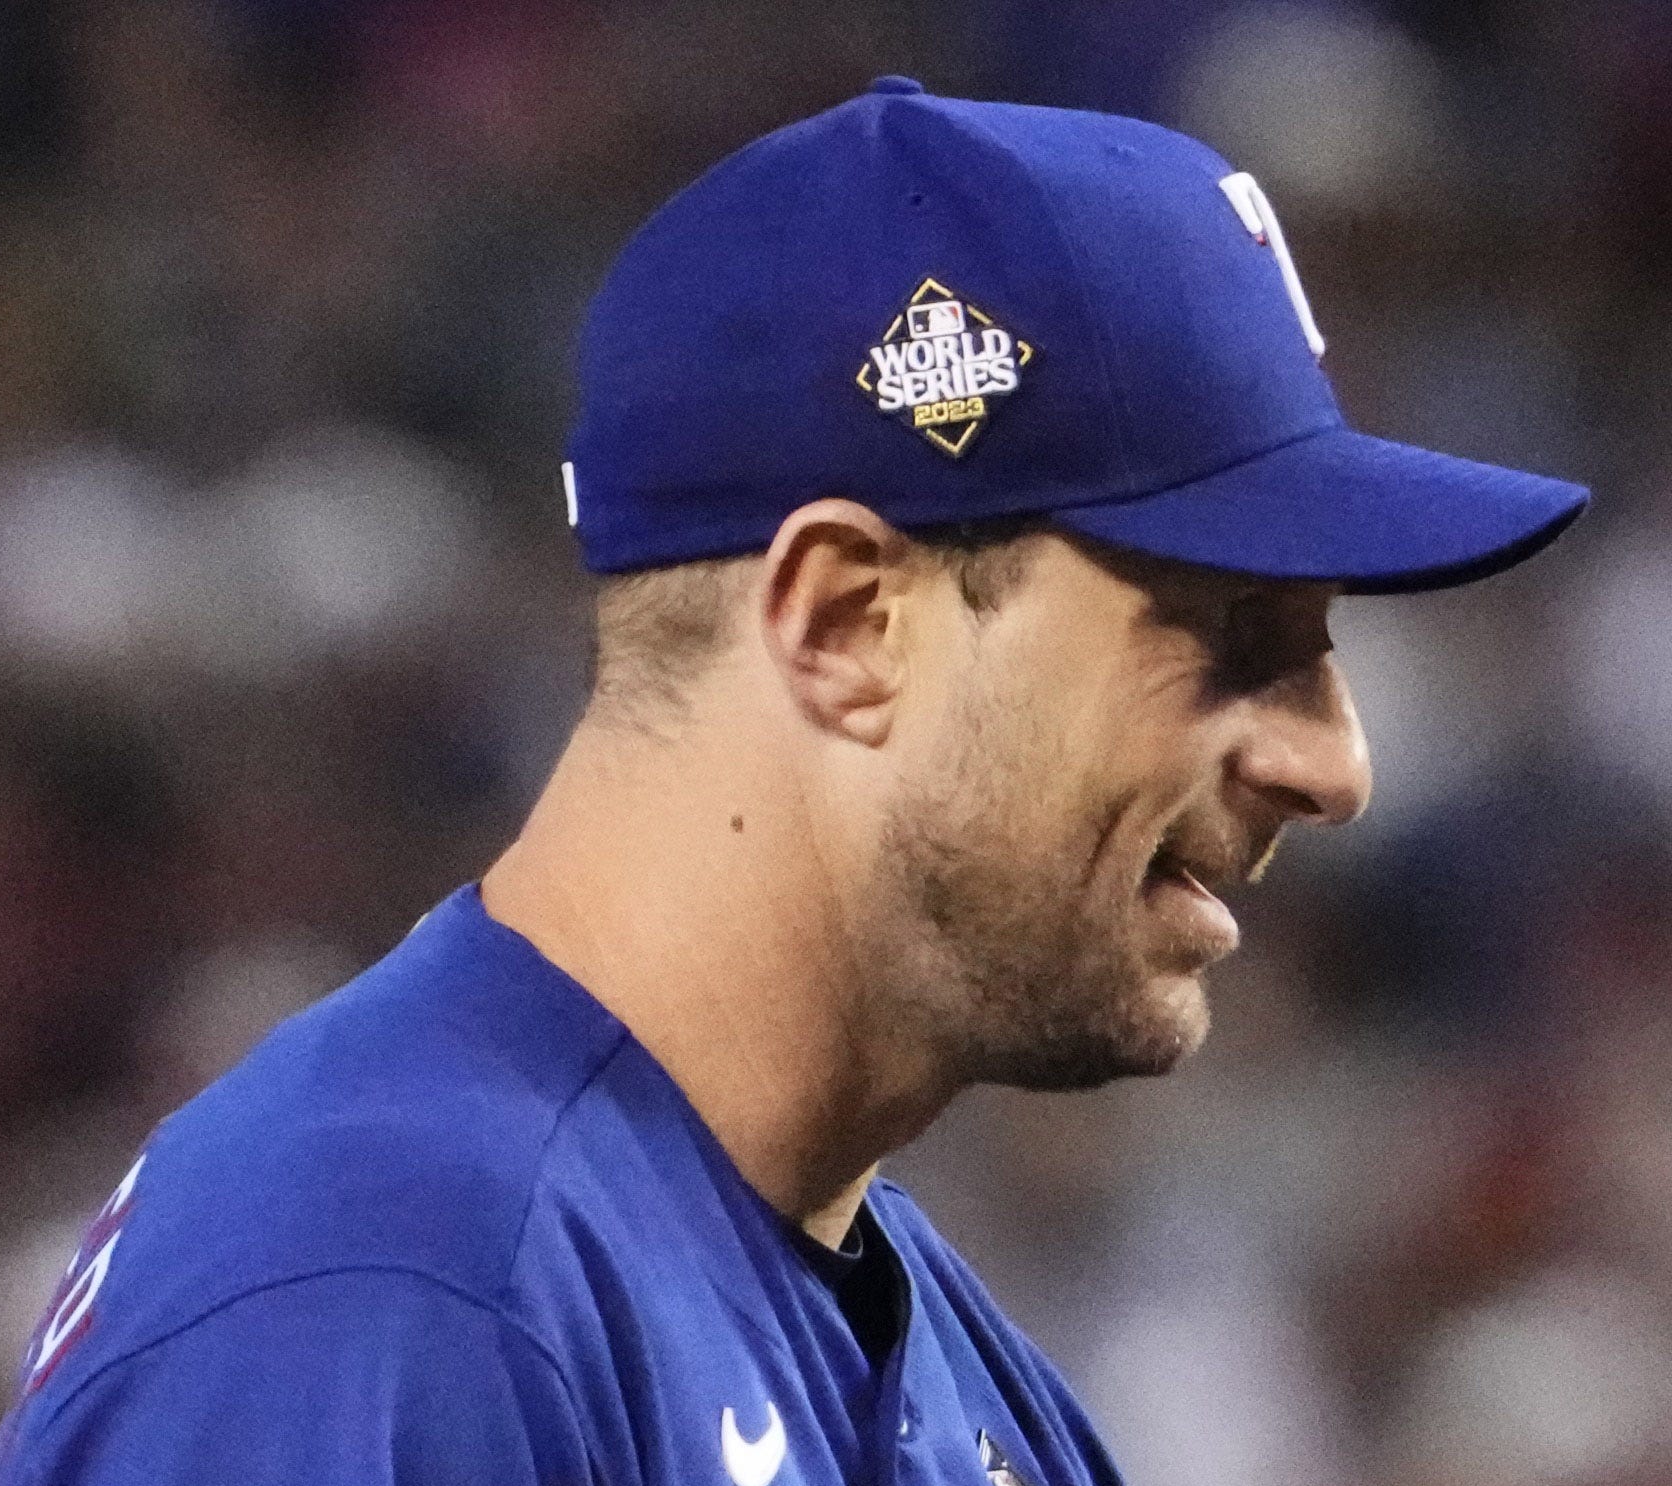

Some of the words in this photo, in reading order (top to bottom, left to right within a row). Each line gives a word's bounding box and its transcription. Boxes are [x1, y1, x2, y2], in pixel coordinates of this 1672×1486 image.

[870, 328, 1012, 378] WORLD
[877, 357, 1018, 410] SERIES
[914, 397, 985, 426] 2023
